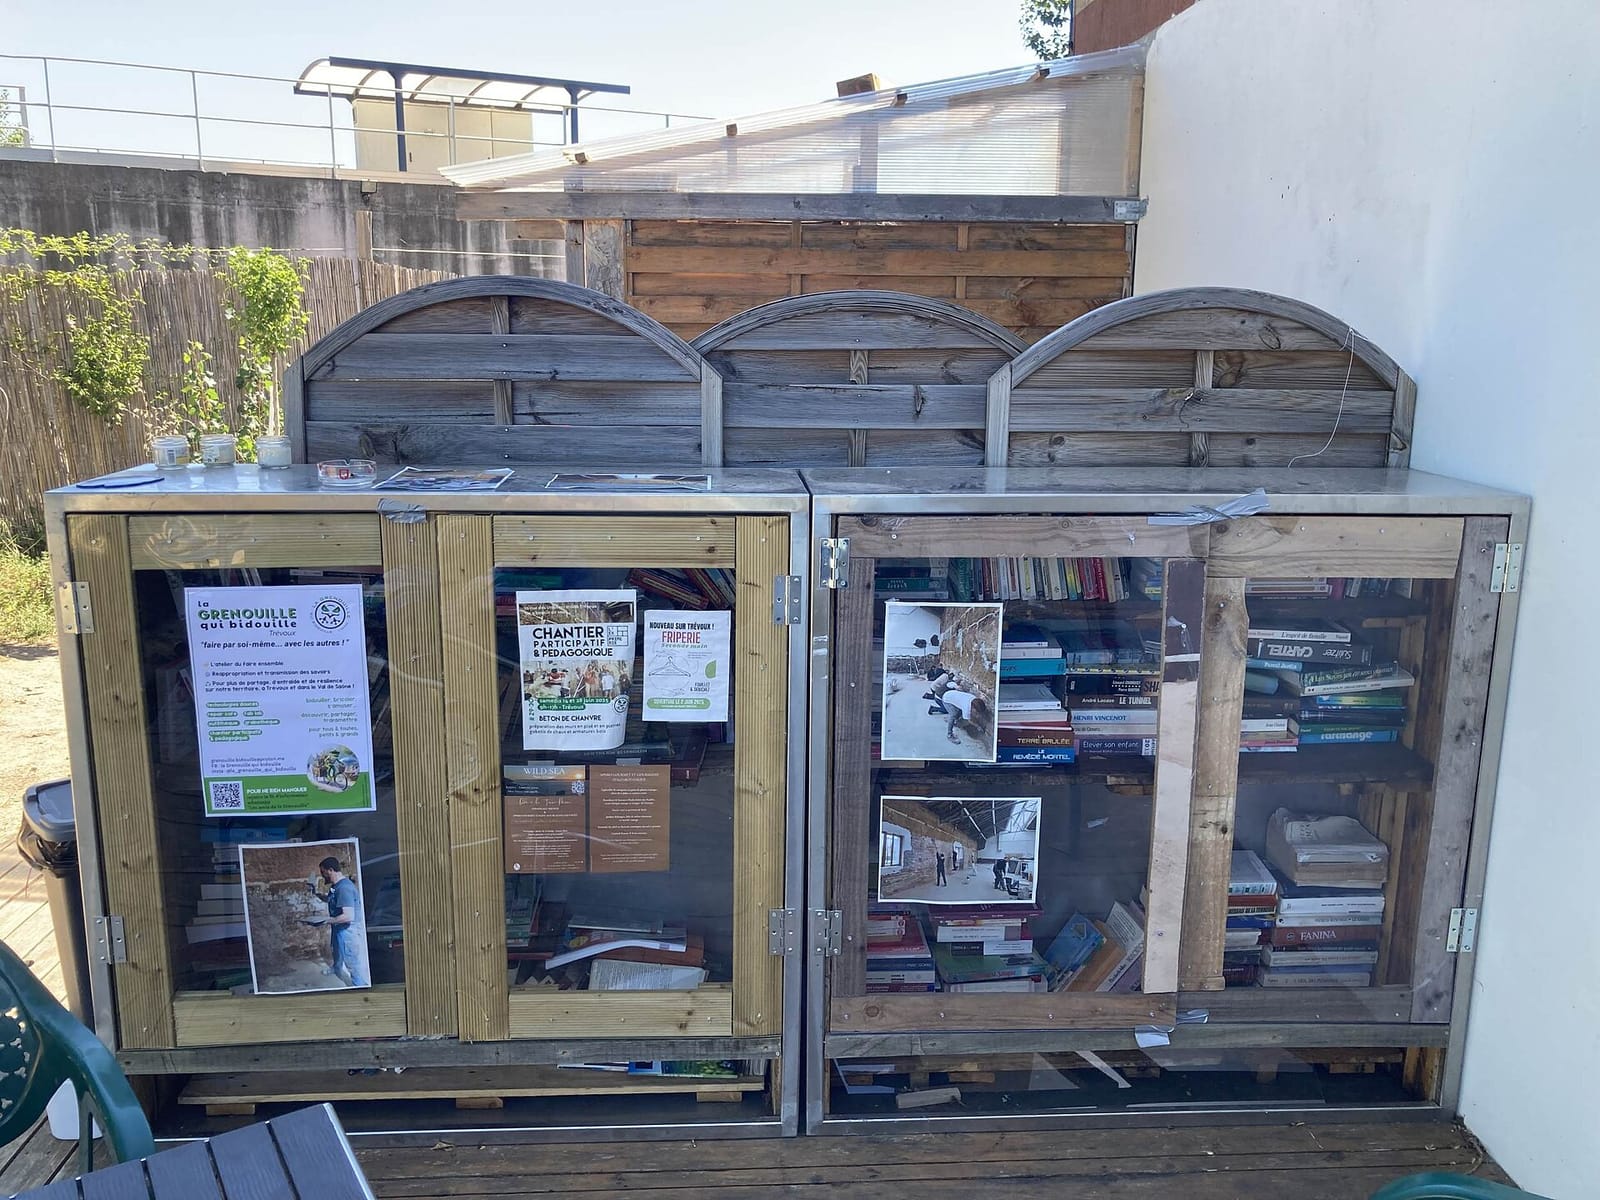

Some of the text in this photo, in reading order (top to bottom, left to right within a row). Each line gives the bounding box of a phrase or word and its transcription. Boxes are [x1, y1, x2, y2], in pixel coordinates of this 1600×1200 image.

[198, 608, 297, 620] GRENOUILLE
[200, 620, 296, 630] qui bidouille
[687, 622, 711, 630] TRÉVOUX
[532, 626, 604, 639] CHANTIER
[662, 631, 701, 643] FRIPERIE
[534, 639, 605, 648] PARTICIPATIF
[534, 649, 540, 657] &
[1267, 644, 1352, 660] Sulitzer CARTEL
[571, 714, 601, 722] CHANVRE
[1300, 930, 1336, 941] FANINA
